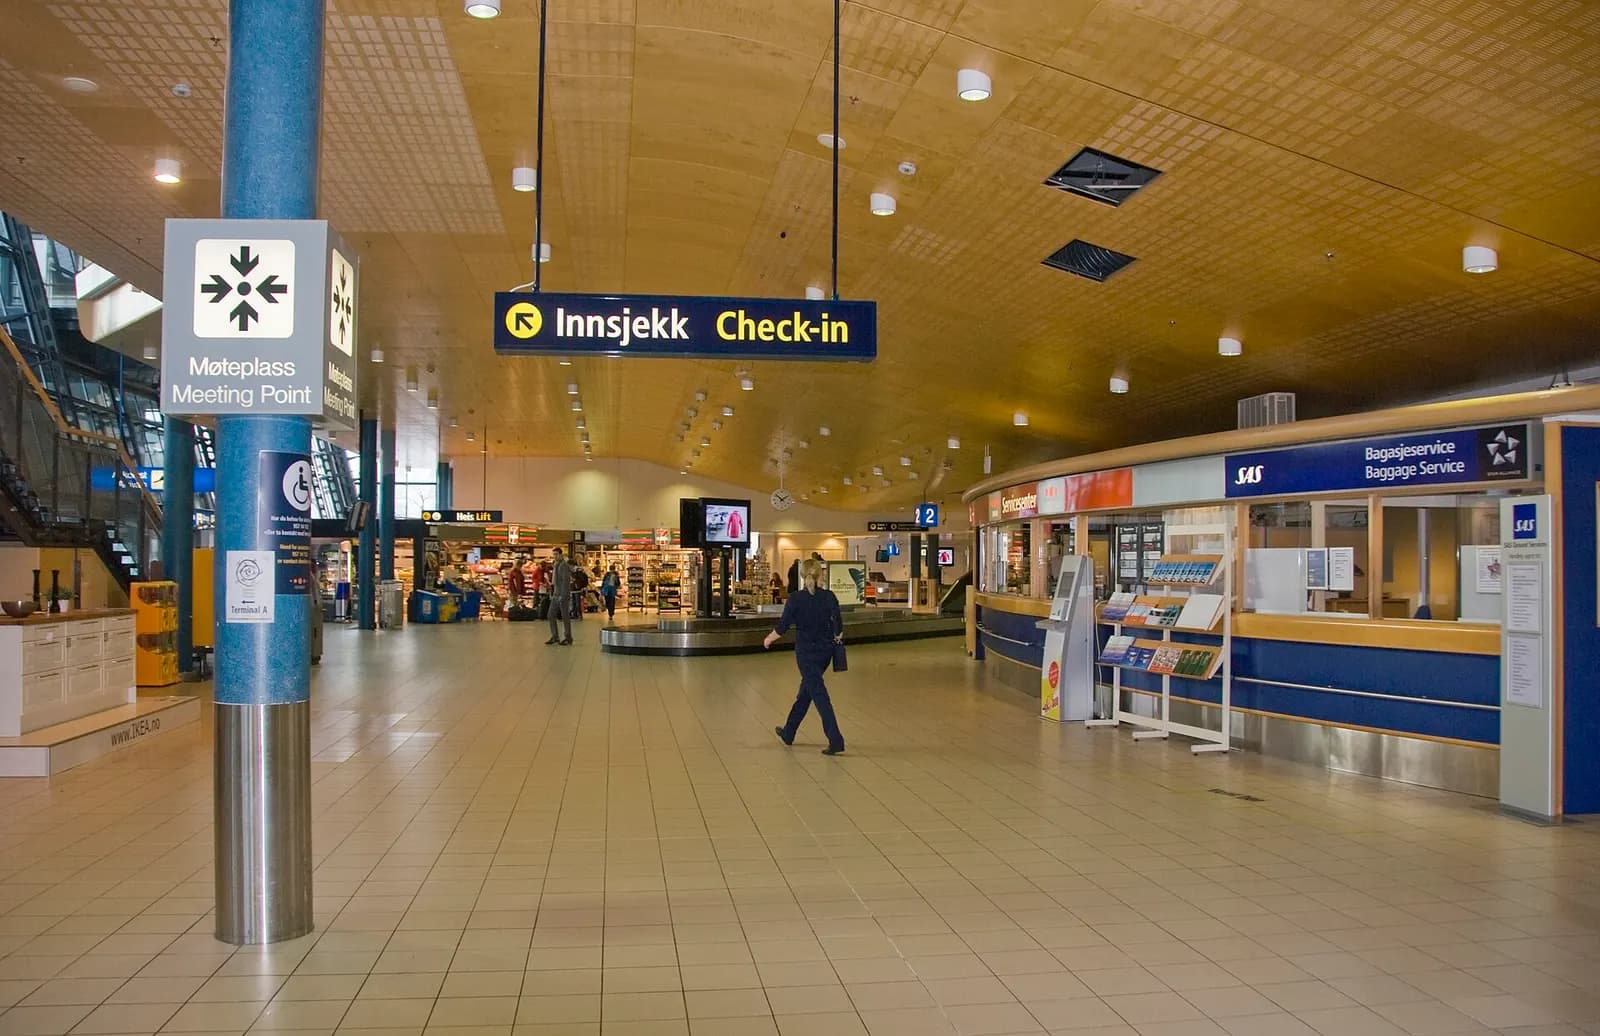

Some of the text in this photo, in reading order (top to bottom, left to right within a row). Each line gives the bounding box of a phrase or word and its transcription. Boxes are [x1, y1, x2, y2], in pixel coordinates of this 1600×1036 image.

[556, 307, 849, 346] Innsjekk Check-in
[189, 356, 296, 380] Møteplass
[172, 384, 312, 408] Meeting Point
[1365, 439, 1456, 463] Bagasjeservice
[1234, 465, 1264, 485] SAS
[1365, 458, 1465, 481] Baggage Service
[456, 511, 492, 521] Heis Lift
[925, 508, 935, 524] 2
[1514, 519, 1535, 532] SAS
[231, 605, 268, 614] Terminal A
[111, 718, 160, 746] www.IKEA.no
